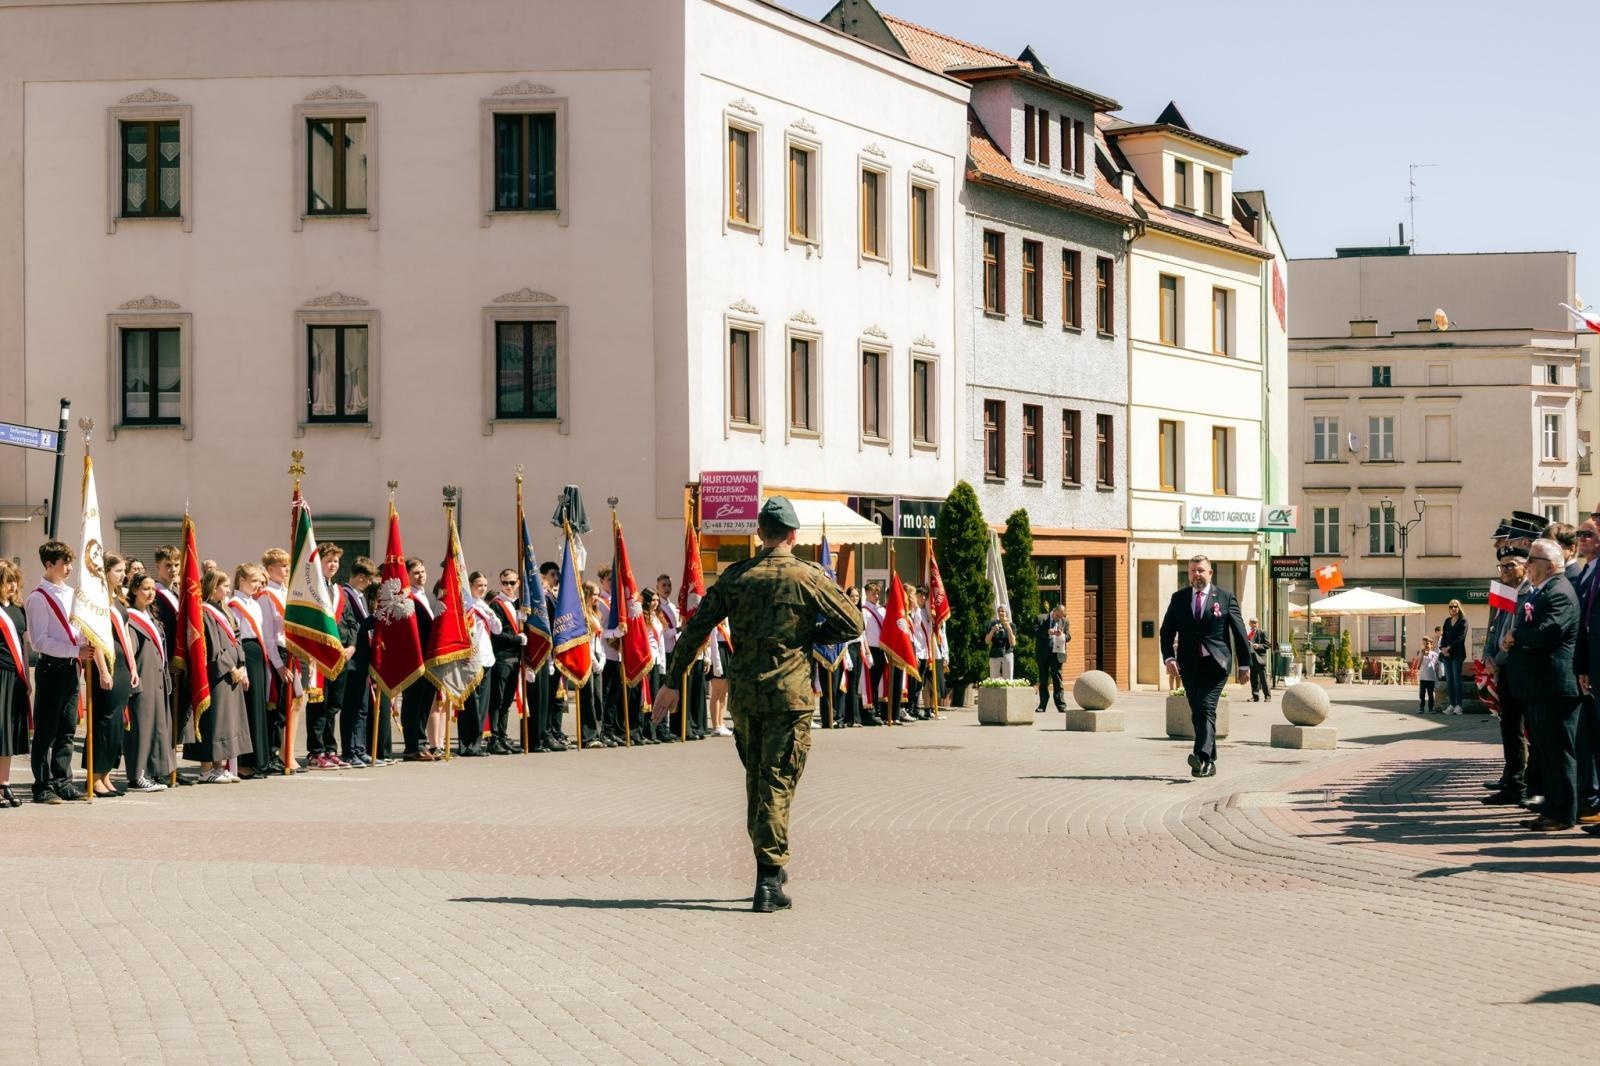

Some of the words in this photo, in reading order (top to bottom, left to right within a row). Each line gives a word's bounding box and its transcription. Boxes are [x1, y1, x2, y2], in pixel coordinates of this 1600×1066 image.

[702, 475, 758, 483] HURTOWNIA
[702, 485, 748, 493] FRYZJERSKO-
[702, 495, 758, 503] -KOSMETYCZNA
[1226, 511, 1256, 522] AGRICOLE
